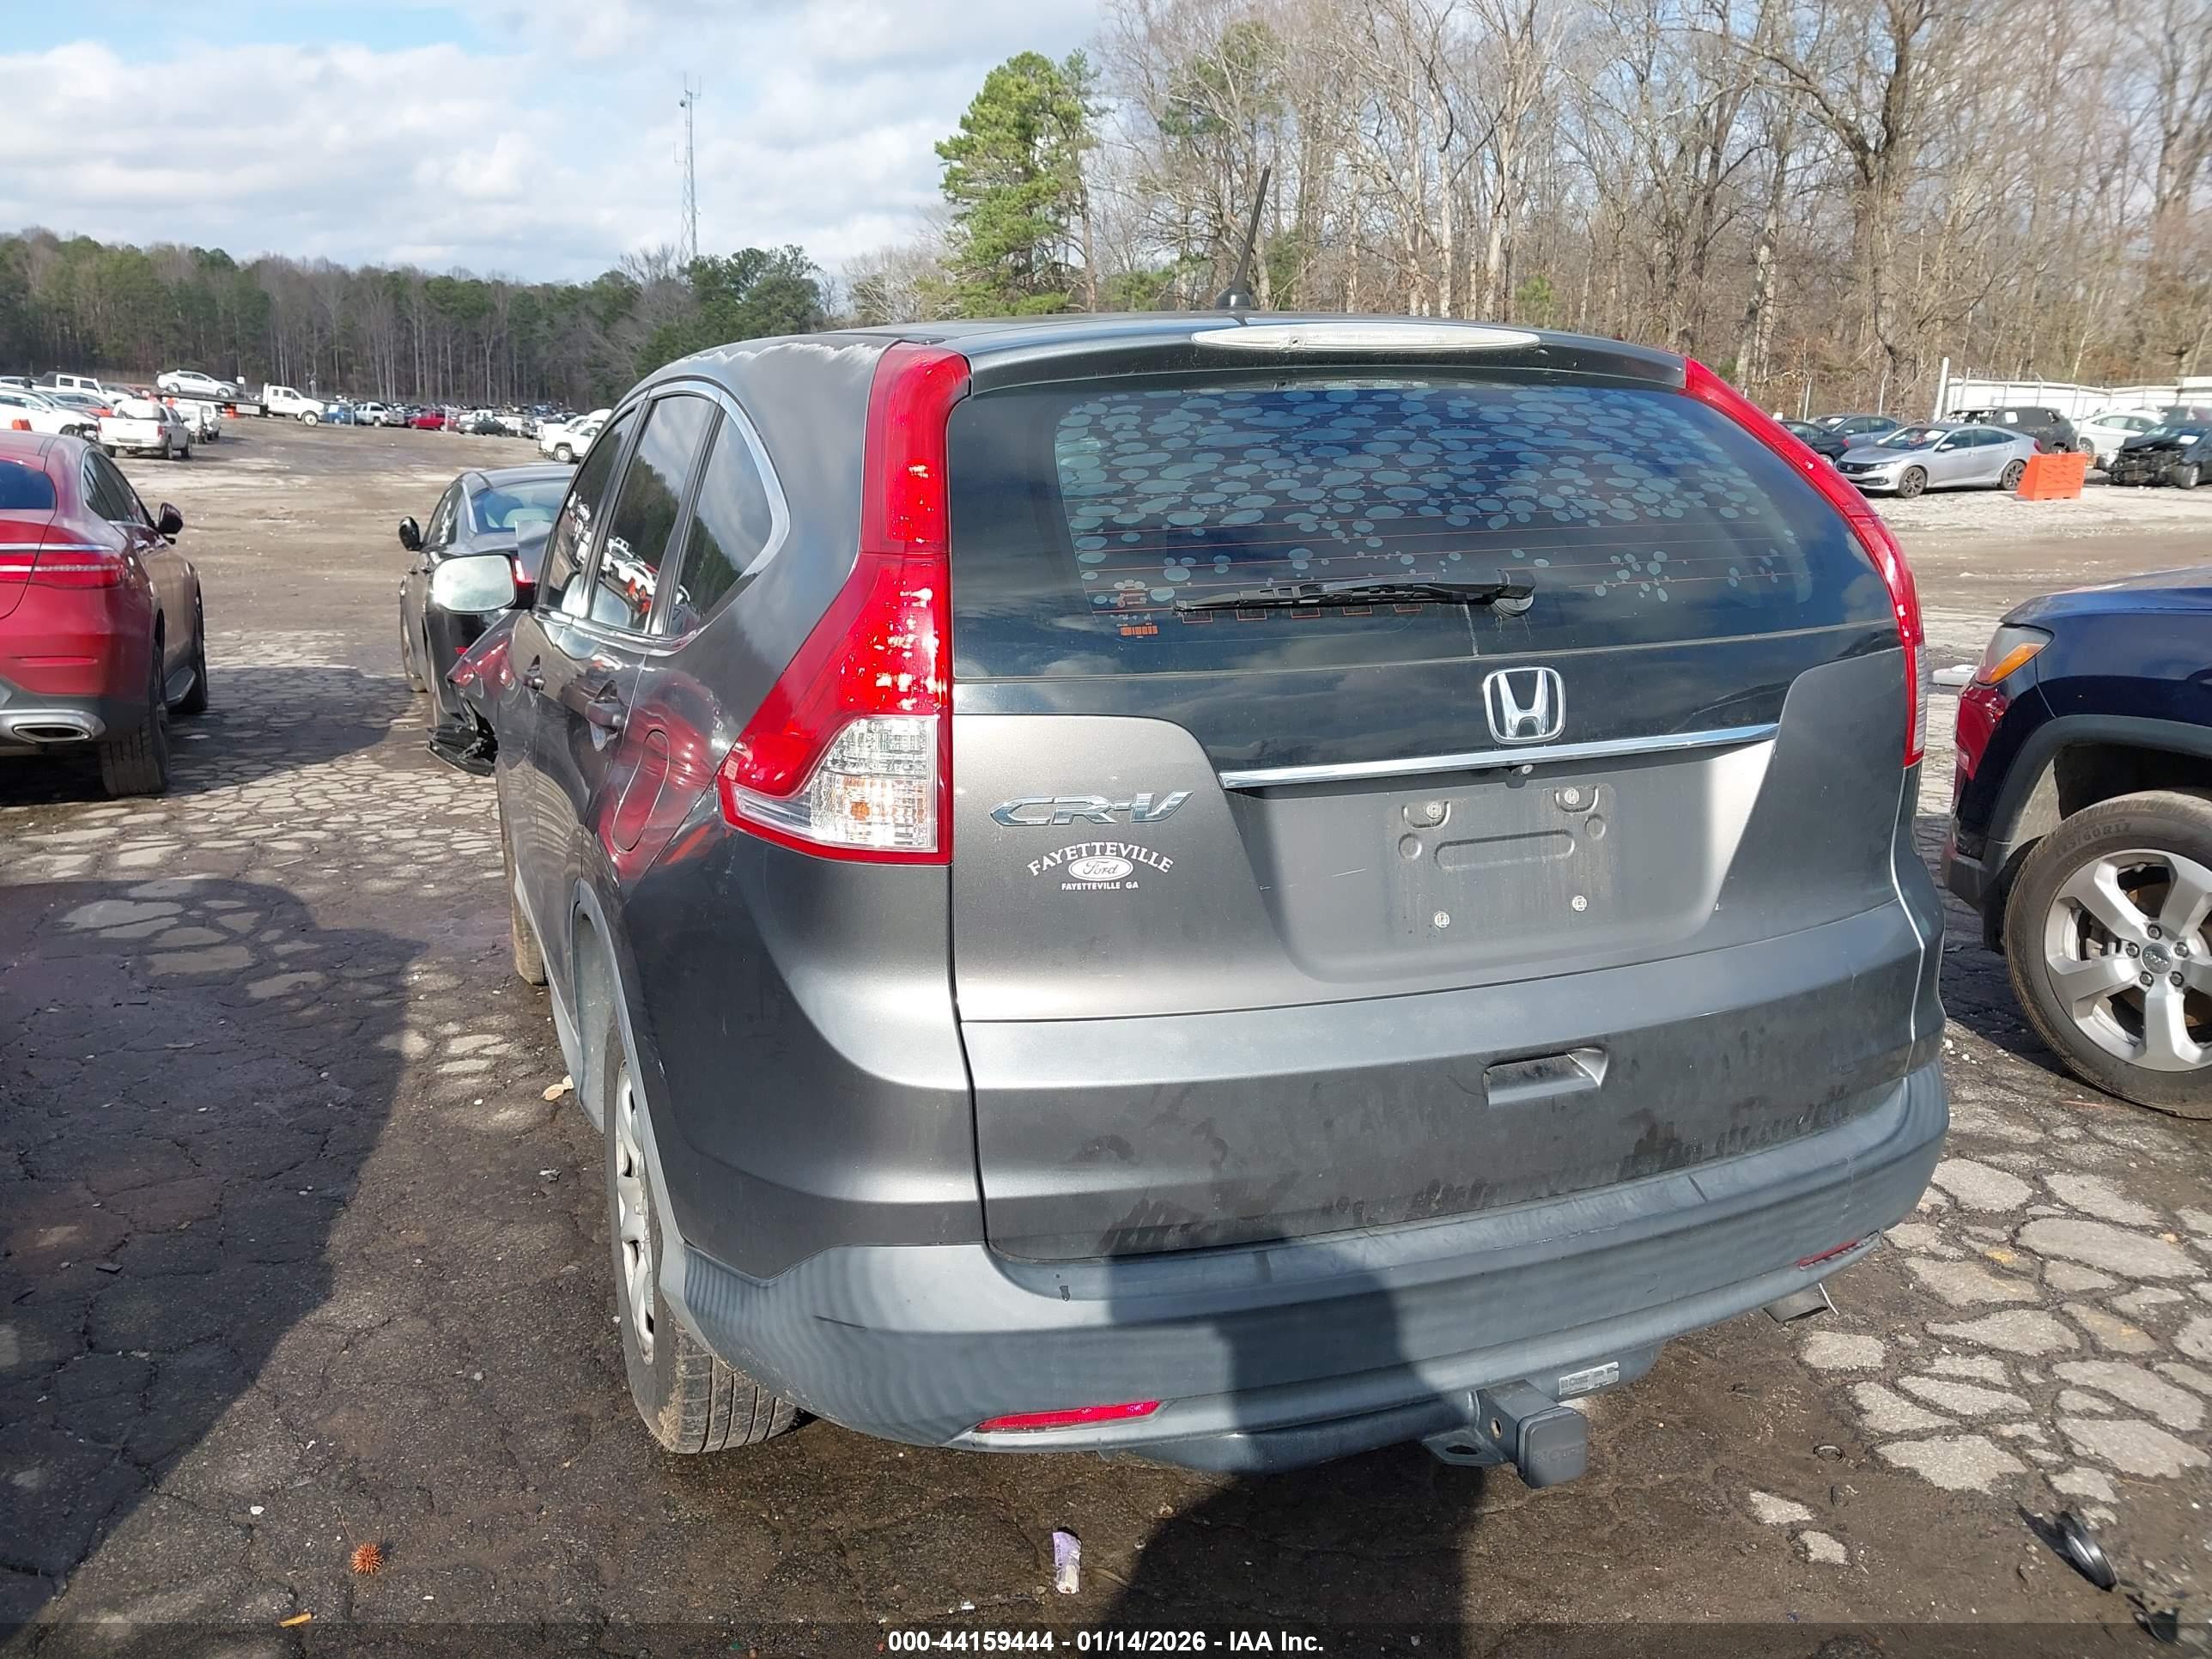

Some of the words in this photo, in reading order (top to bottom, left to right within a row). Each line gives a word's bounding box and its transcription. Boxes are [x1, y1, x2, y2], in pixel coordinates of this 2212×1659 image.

[989, 790, 1194, 827] CR-V
[1026, 842, 1175, 877] FAYETTEVILLE
[1082, 860, 1119, 876] Ford
[1061, 882, 1121, 891] FAYETTEVILLE
[1125, 881, 1139, 890] GA
